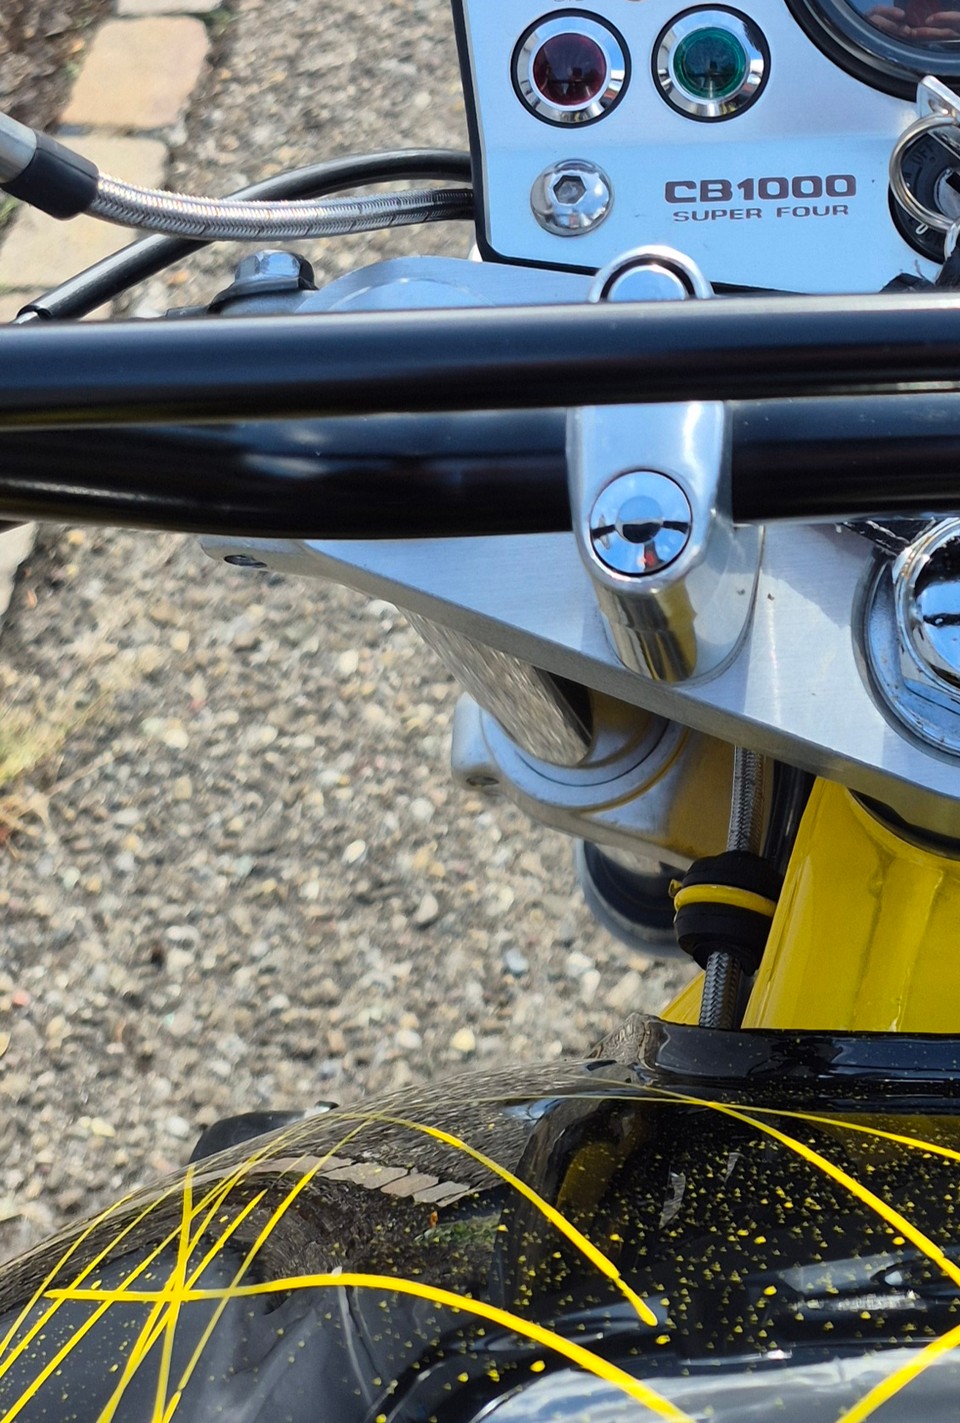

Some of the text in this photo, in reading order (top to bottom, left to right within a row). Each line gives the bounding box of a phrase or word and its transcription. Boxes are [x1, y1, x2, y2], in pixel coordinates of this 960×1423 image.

[664, 175, 856, 203] CB1000
[673, 205, 849, 222] SUPER FOUR
